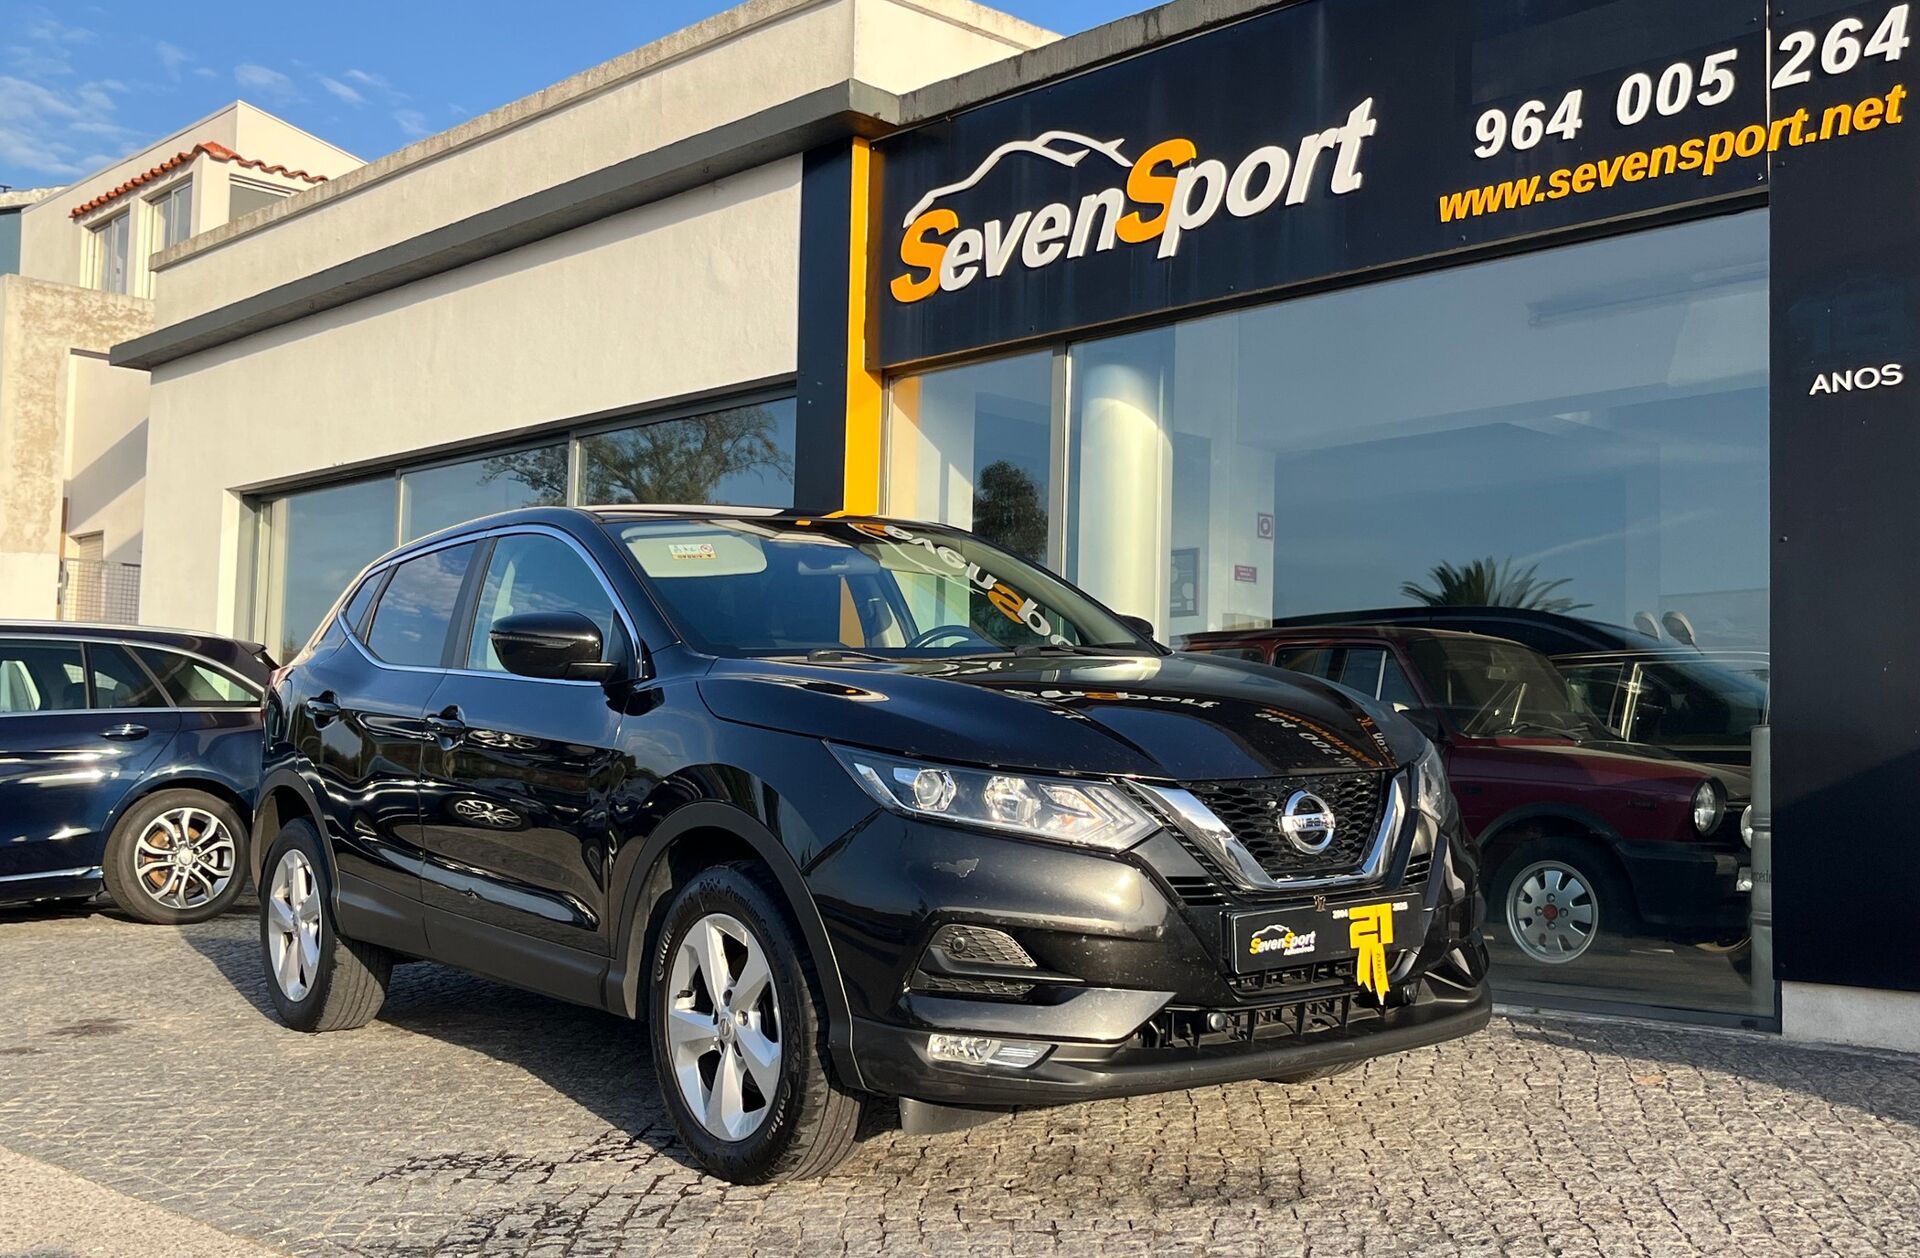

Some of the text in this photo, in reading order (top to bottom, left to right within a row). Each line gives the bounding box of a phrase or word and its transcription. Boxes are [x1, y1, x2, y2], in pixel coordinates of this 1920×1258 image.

[1474, 4, 1910, 159] 964 005 264
[890, 97, 1377, 303] SevenSport
[1439, 83, 1907, 223] www.sevensport.net
[1809, 363, 1904, 395] ANOS
[1249, 930, 1316, 954] SevenSport
